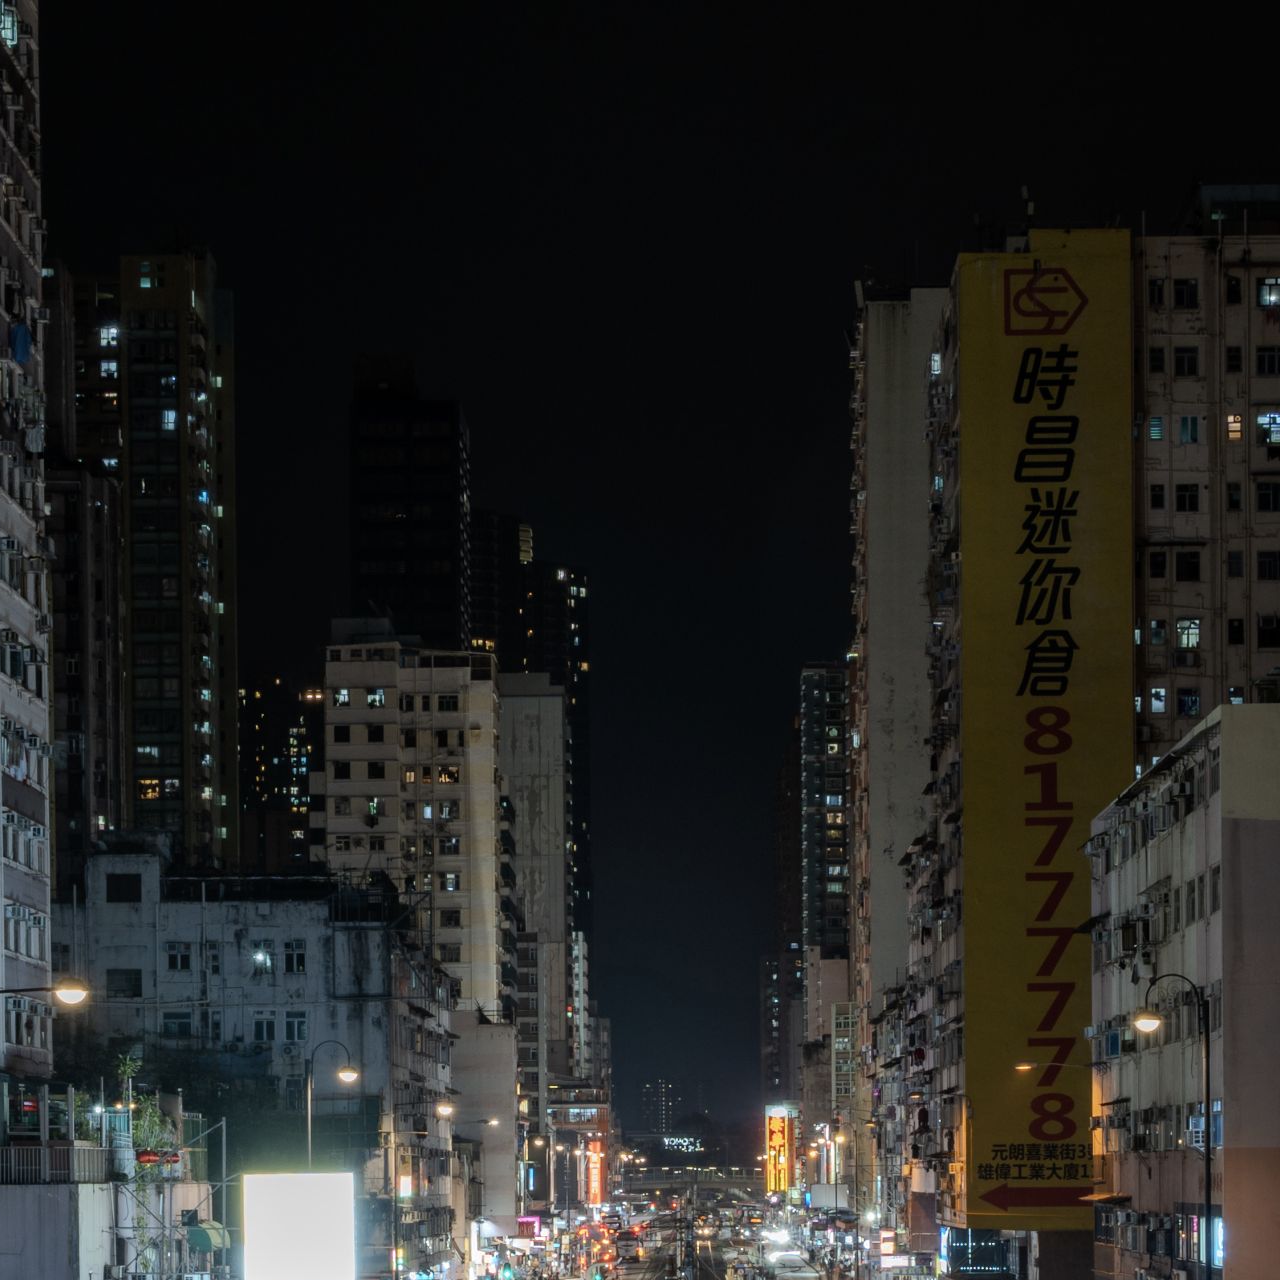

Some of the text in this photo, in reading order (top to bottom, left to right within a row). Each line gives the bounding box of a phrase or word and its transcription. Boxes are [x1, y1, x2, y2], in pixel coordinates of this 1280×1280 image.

[1013, 343, 1081, 698] 時昌迷你倉
[1023, 706, 1078, 1142] 81777778
